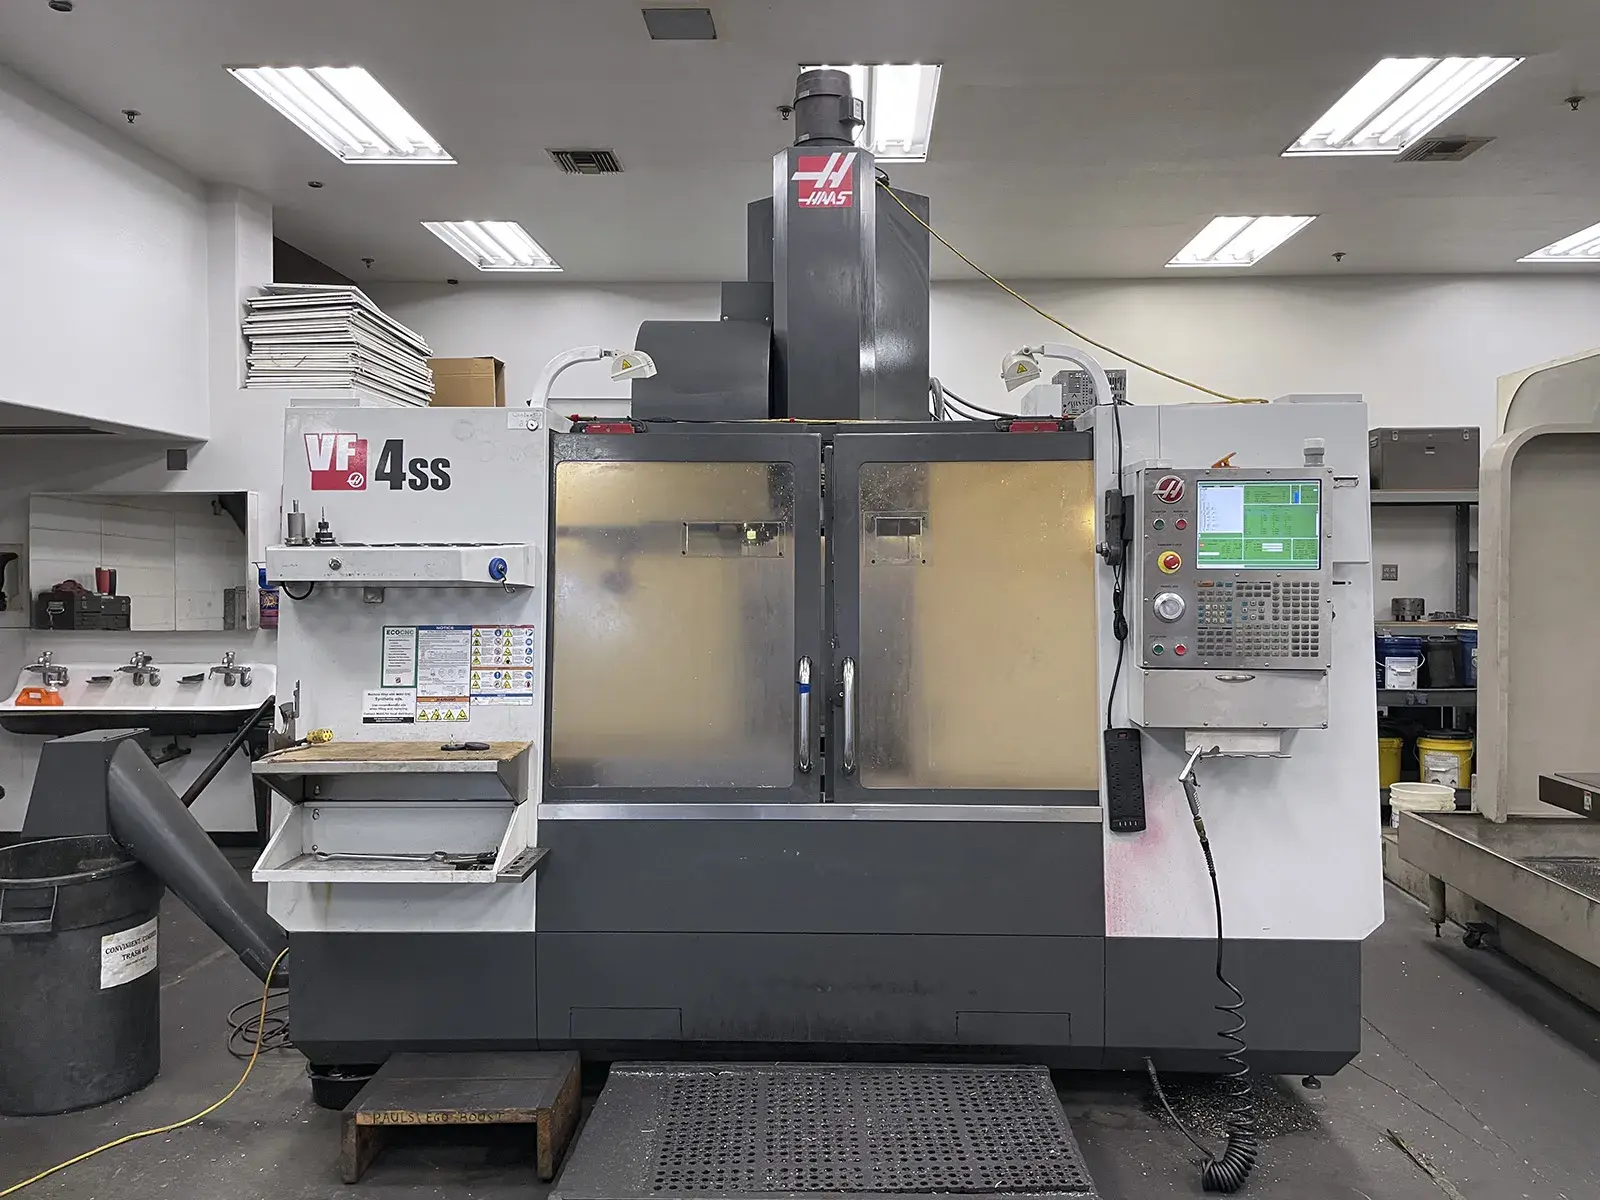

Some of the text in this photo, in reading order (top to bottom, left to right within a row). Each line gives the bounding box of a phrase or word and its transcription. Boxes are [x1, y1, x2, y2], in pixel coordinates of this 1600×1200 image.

[798, 190, 853, 206] HAAS
[304, 433, 358, 472] VF
[121, 949, 142, 961] TRASH
[426, 1112, 449, 1122] EGO
[460, 1111, 505, 1122] BOOST
